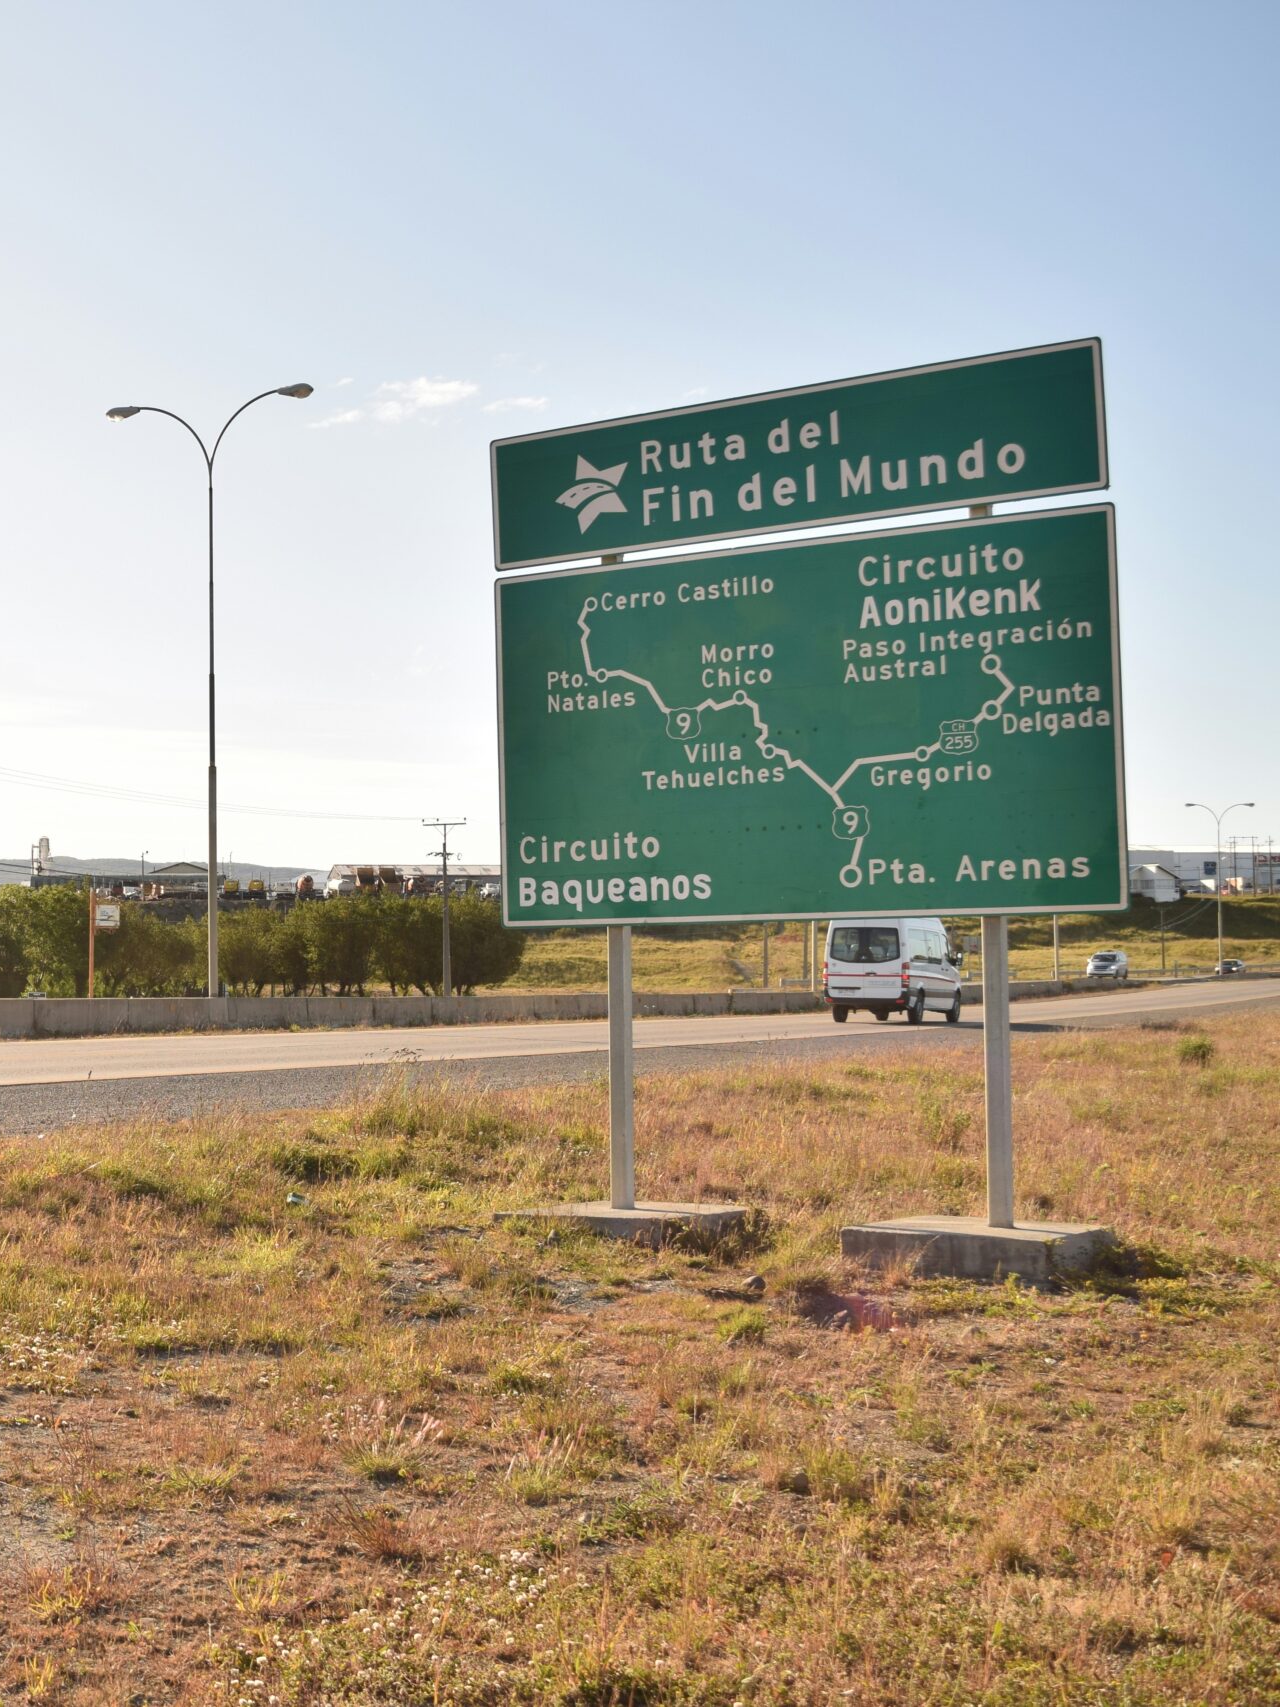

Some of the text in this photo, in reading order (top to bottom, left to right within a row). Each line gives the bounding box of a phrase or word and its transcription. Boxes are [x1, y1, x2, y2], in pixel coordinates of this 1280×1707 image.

[641, 410, 839, 474] Ruta del
[643, 439, 1025, 526] Fin del Mundo
[858, 543, 1024, 587] Circuito
[601, 575, 774, 612] Cerro Castillo
[843, 616, 1092, 660] Paso Integración
[701, 643, 774, 665] Morro
[547, 671, 588, 690] Pto.
[701, 667, 772, 688] Chico
[844, 654, 946, 684] Austral
[548, 690, 636, 713] Natales
[1019, 682, 1100, 707] Punta
[676, 712, 692, 735] 9
[951, 722, 966, 732] CH
[1002, 707, 1110, 737] Delgada
[683, 742, 742, 764] Villa
[945, 735, 973, 750] 255
[641, 765, 785, 790] Tehuelches
[870, 760, 992, 791] Gregorio
[842, 811, 859, 834] 9
[519, 830, 660, 864] Circuito
[868, 854, 1090, 885] Pta. Arenas
[519, 873, 712, 913] Baqueanos
